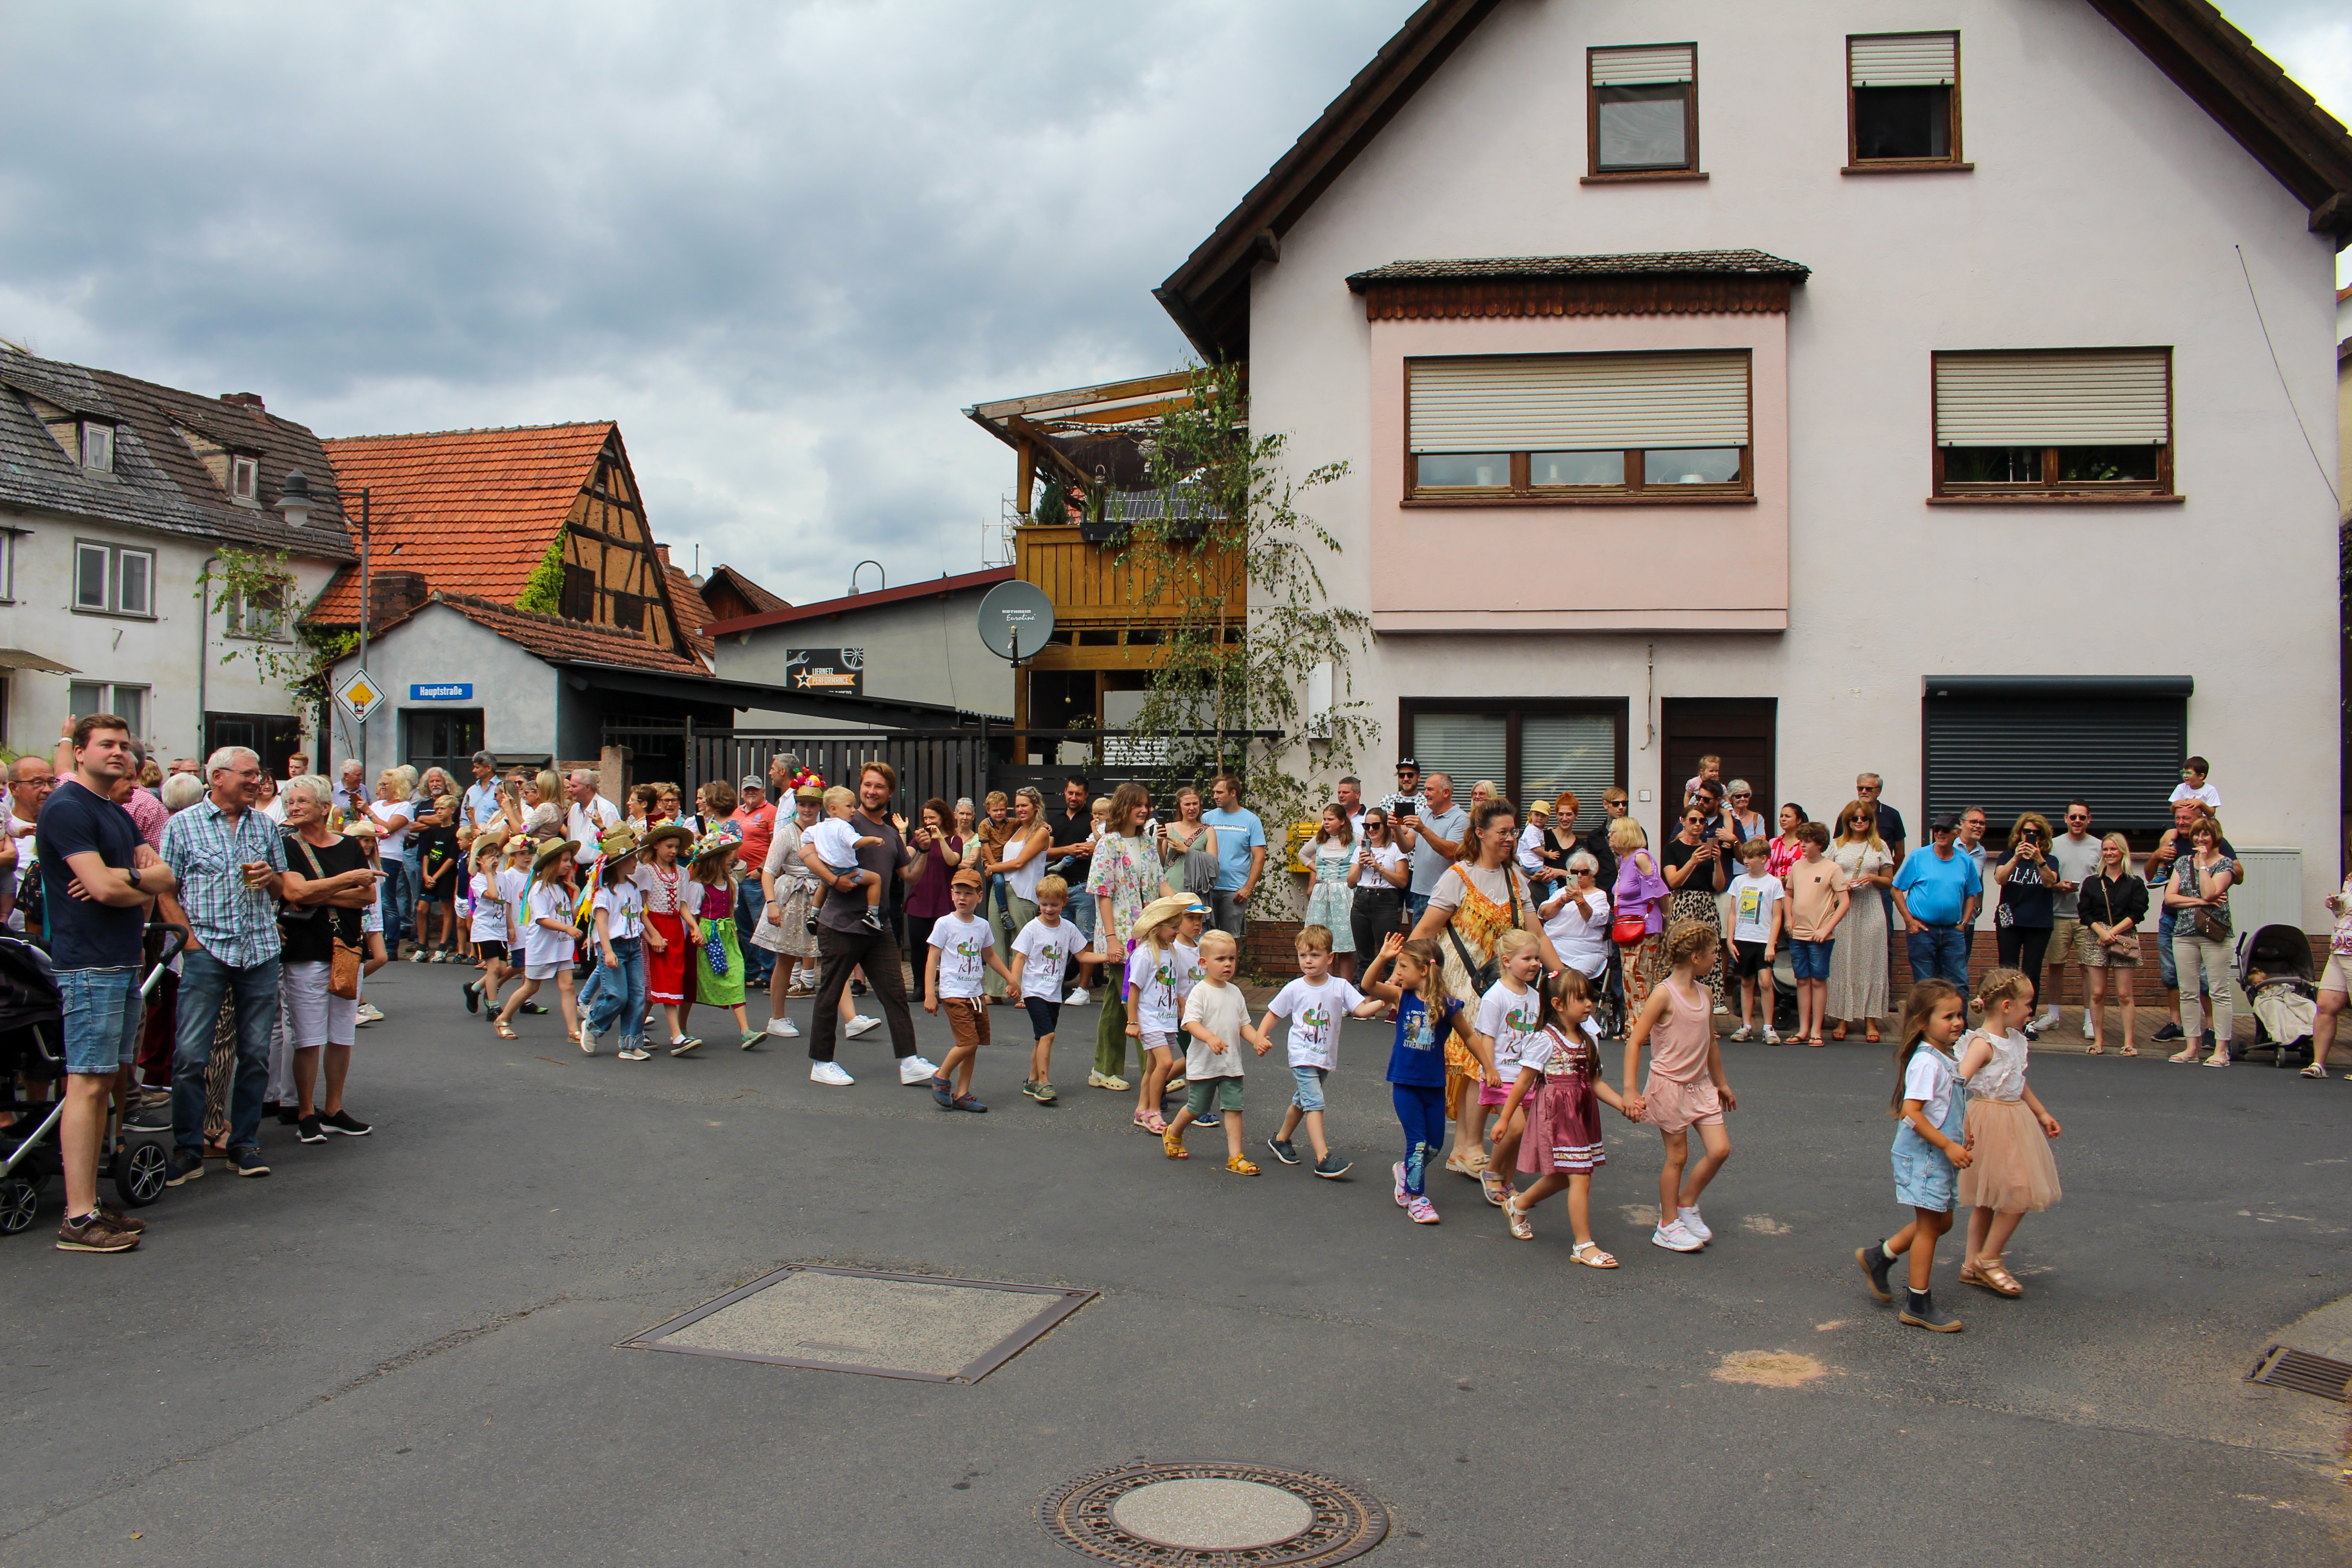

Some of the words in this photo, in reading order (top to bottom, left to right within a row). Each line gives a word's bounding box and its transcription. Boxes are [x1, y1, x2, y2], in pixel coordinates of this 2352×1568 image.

[812, 676, 848, 684] PERFORMANCE
[420, 686, 462, 698] Hauptstraße
[1403, 1039, 1431, 1051] STRENGTH
